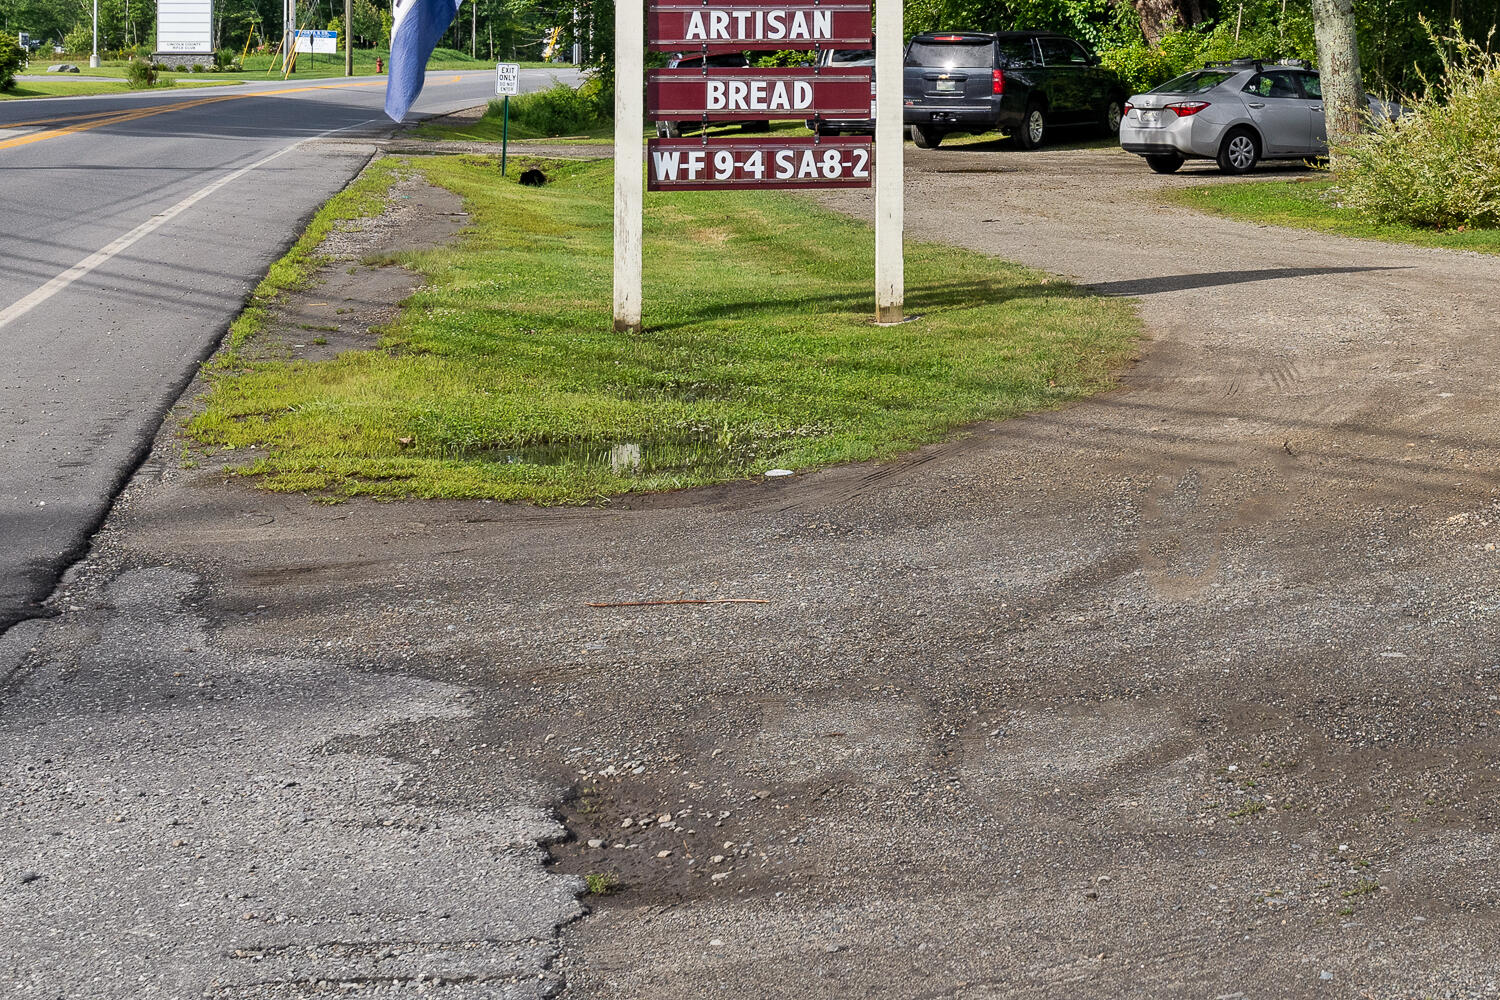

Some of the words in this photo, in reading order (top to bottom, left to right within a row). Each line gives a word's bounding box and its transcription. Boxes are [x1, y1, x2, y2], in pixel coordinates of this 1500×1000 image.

[685, 10, 832, 40] ARTISAN
[707, 80, 813, 110] BREAD
[652, 151, 706, 181] W-F
[714, 150, 765, 180] 9-4
